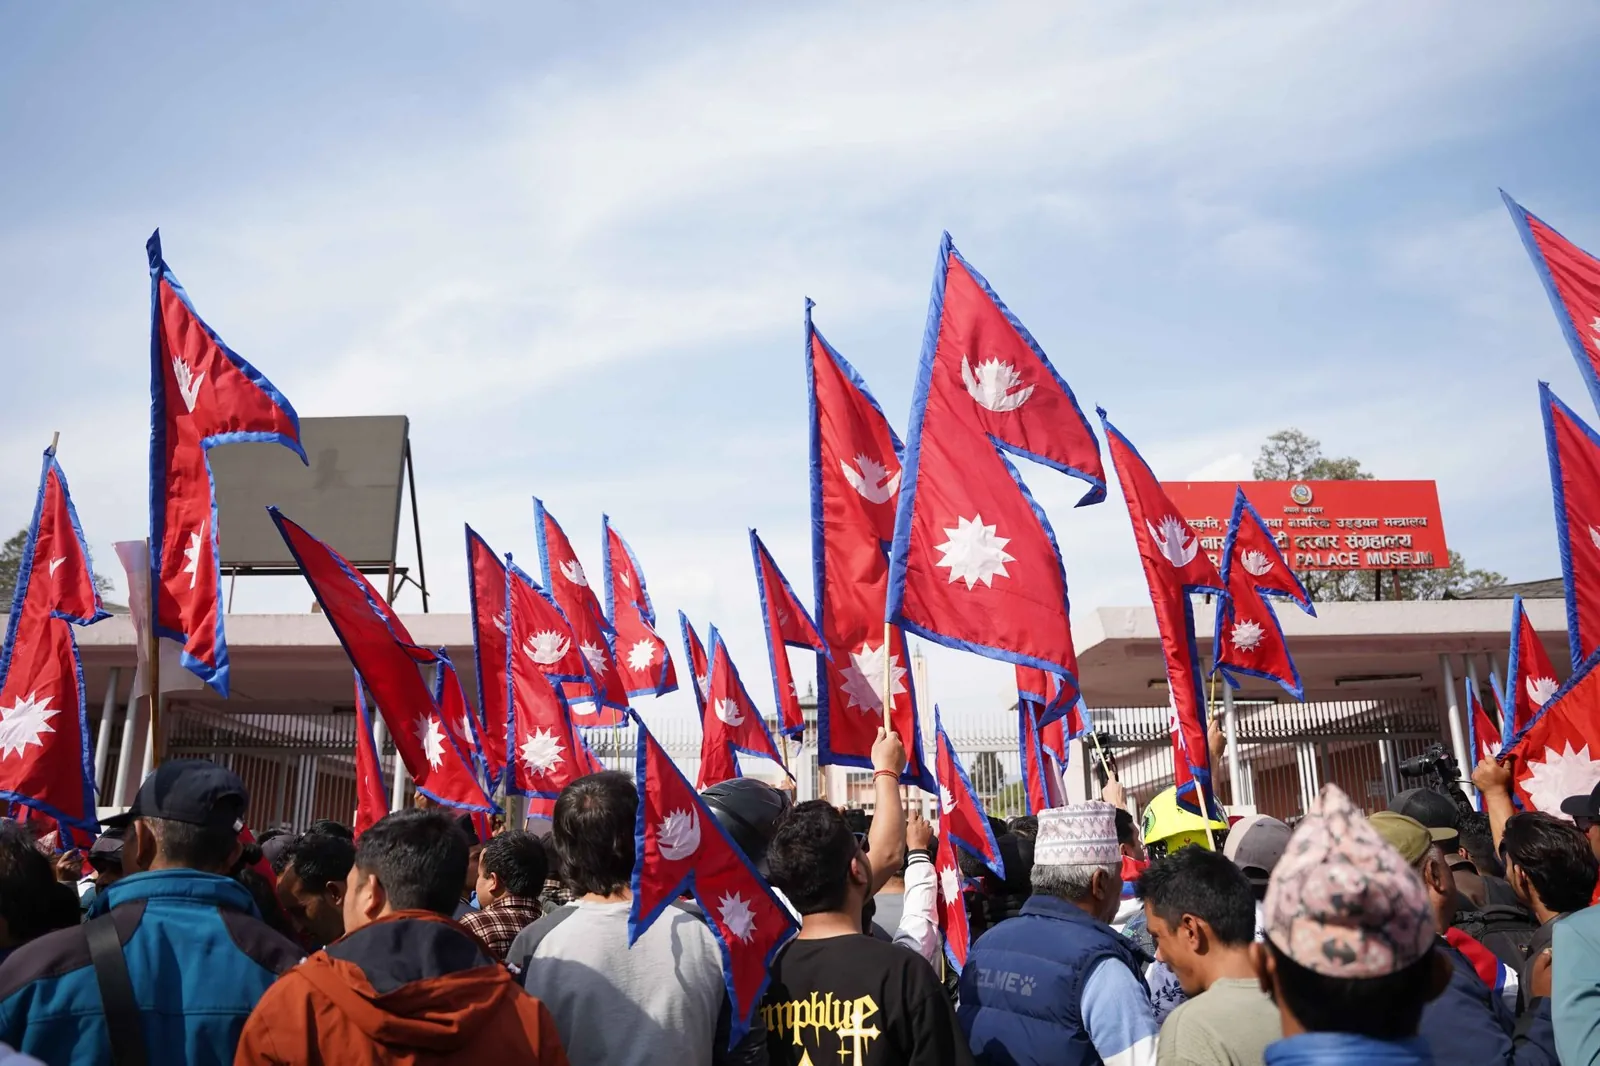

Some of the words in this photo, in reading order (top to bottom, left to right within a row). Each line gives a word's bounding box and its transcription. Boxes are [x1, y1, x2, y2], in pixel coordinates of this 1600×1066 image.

[1187, 515, 1222, 532] स्कृति,
[1295, 534, 1339, 549] दरबार
[1345, 532, 1411, 550] संग्रहालय
[1295, 553, 1359, 566] PALACE
[1366, 551, 1432, 565] MUSEUM
